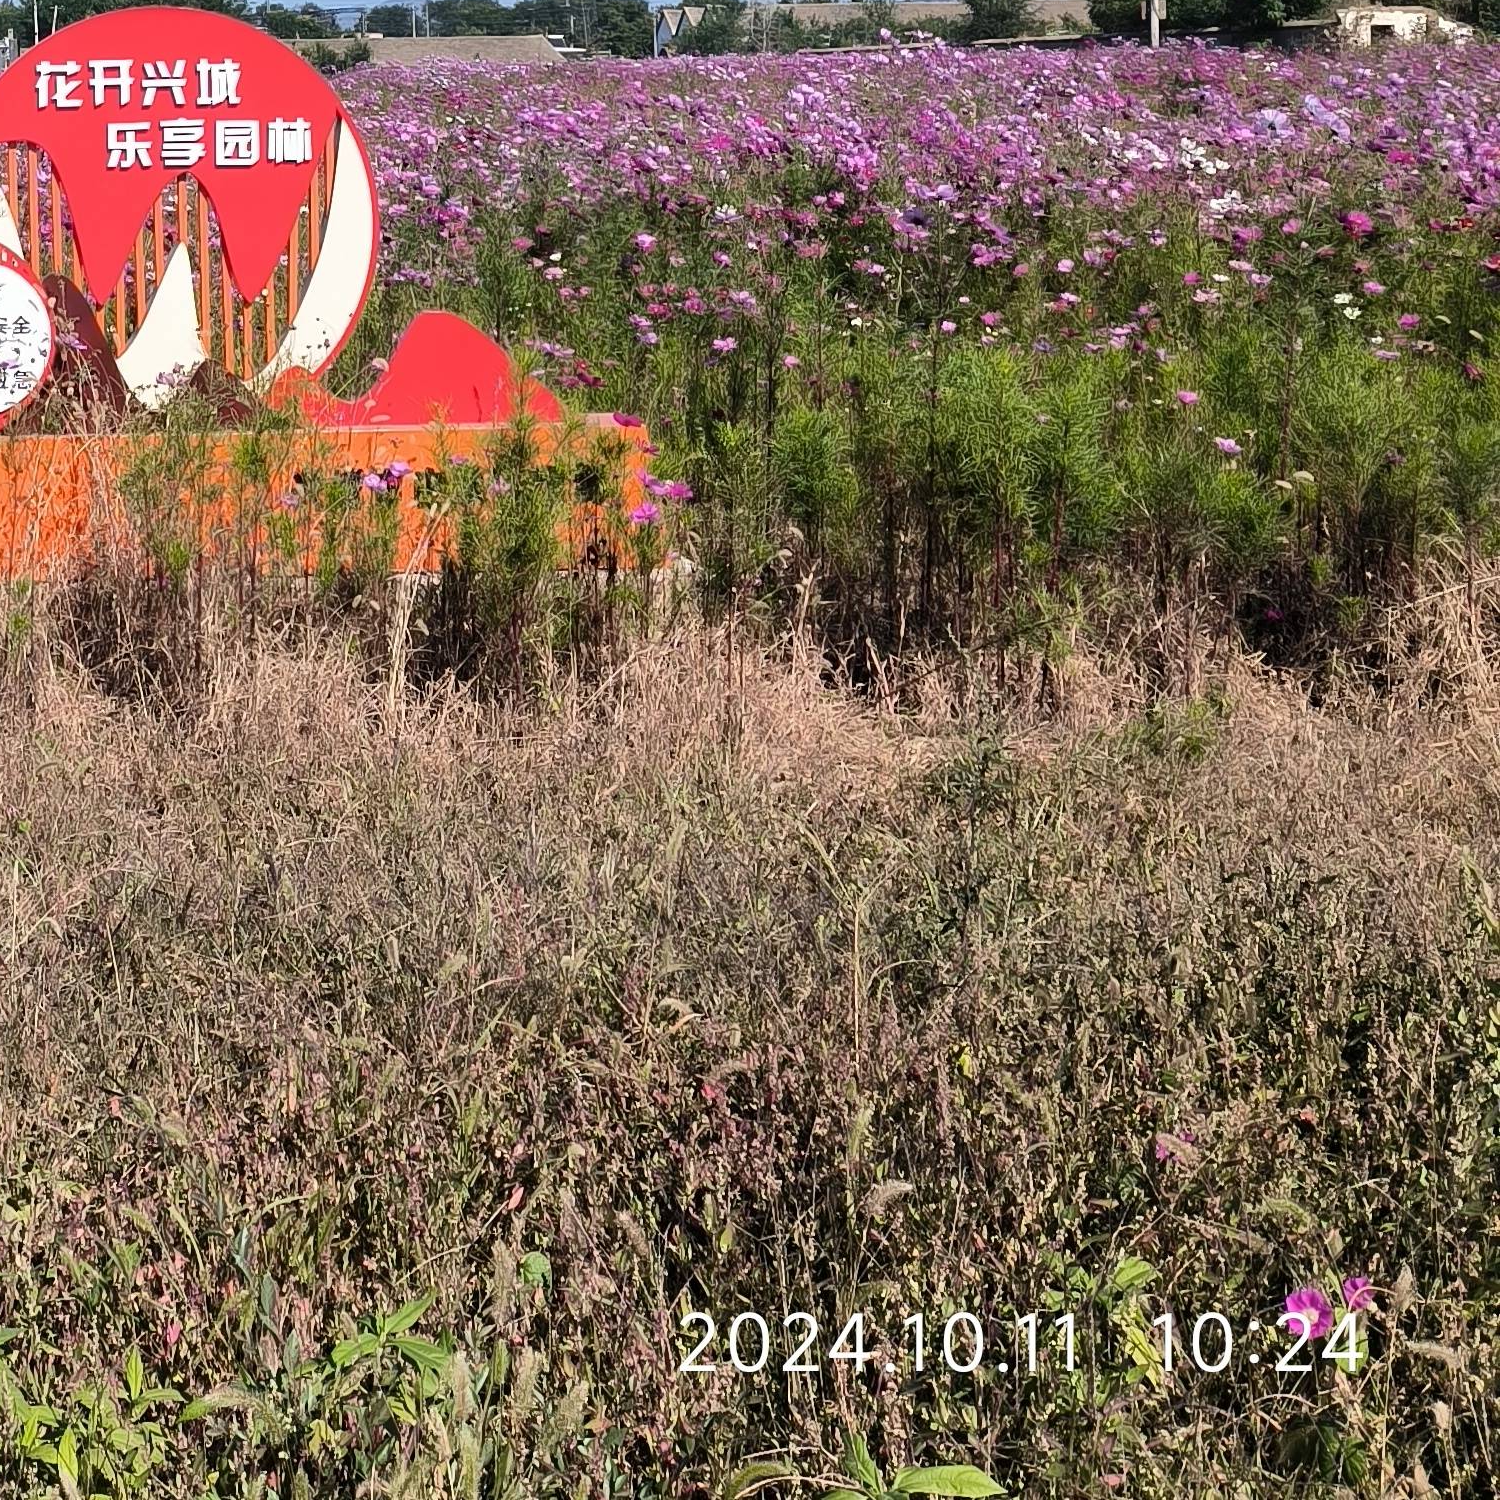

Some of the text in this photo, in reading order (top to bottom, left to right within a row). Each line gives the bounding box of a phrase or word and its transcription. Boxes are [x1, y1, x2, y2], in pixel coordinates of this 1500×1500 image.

[34, 57, 242, 108] 花开兴城
[106, 117, 313, 169] 乐享园林
